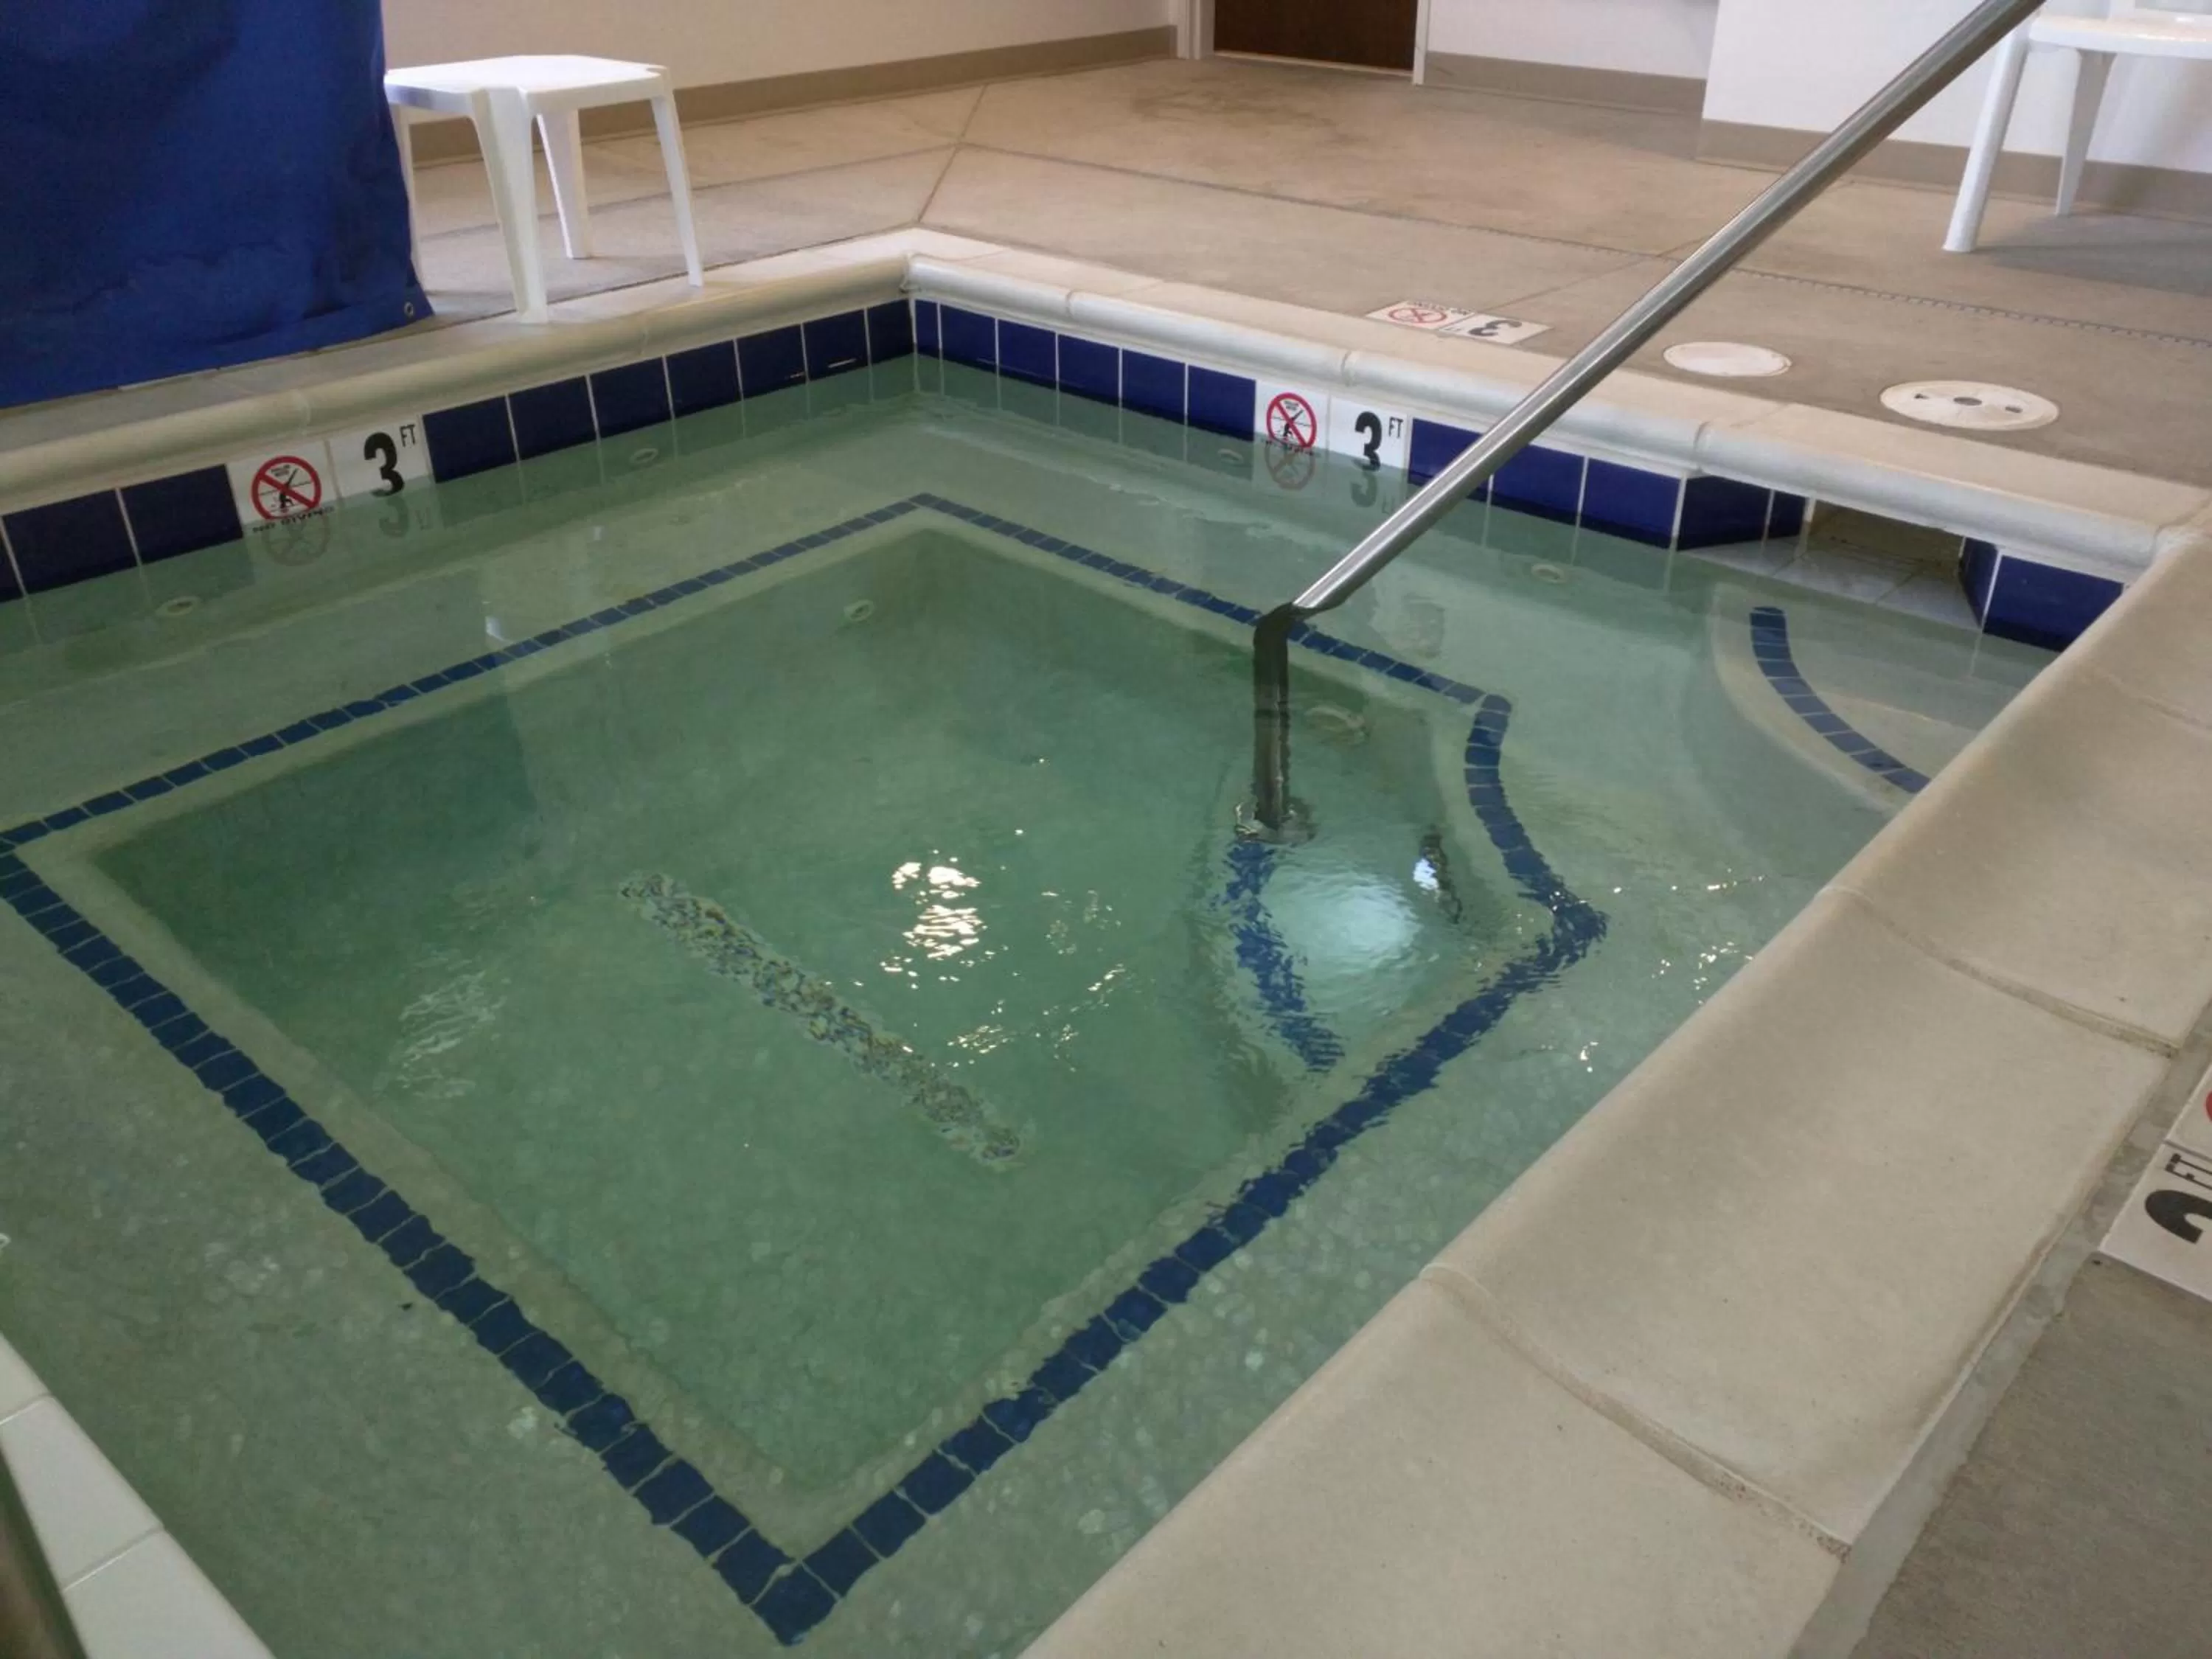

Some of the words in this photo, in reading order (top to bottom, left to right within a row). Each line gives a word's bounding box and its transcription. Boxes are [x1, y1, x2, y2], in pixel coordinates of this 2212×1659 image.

[1468, 320, 1523, 336] 3
[364, 432, 404, 497] 3
[400, 424, 415, 447] FT
[1355, 411, 1382, 473] 3
[1388, 417, 1404, 439] FT
